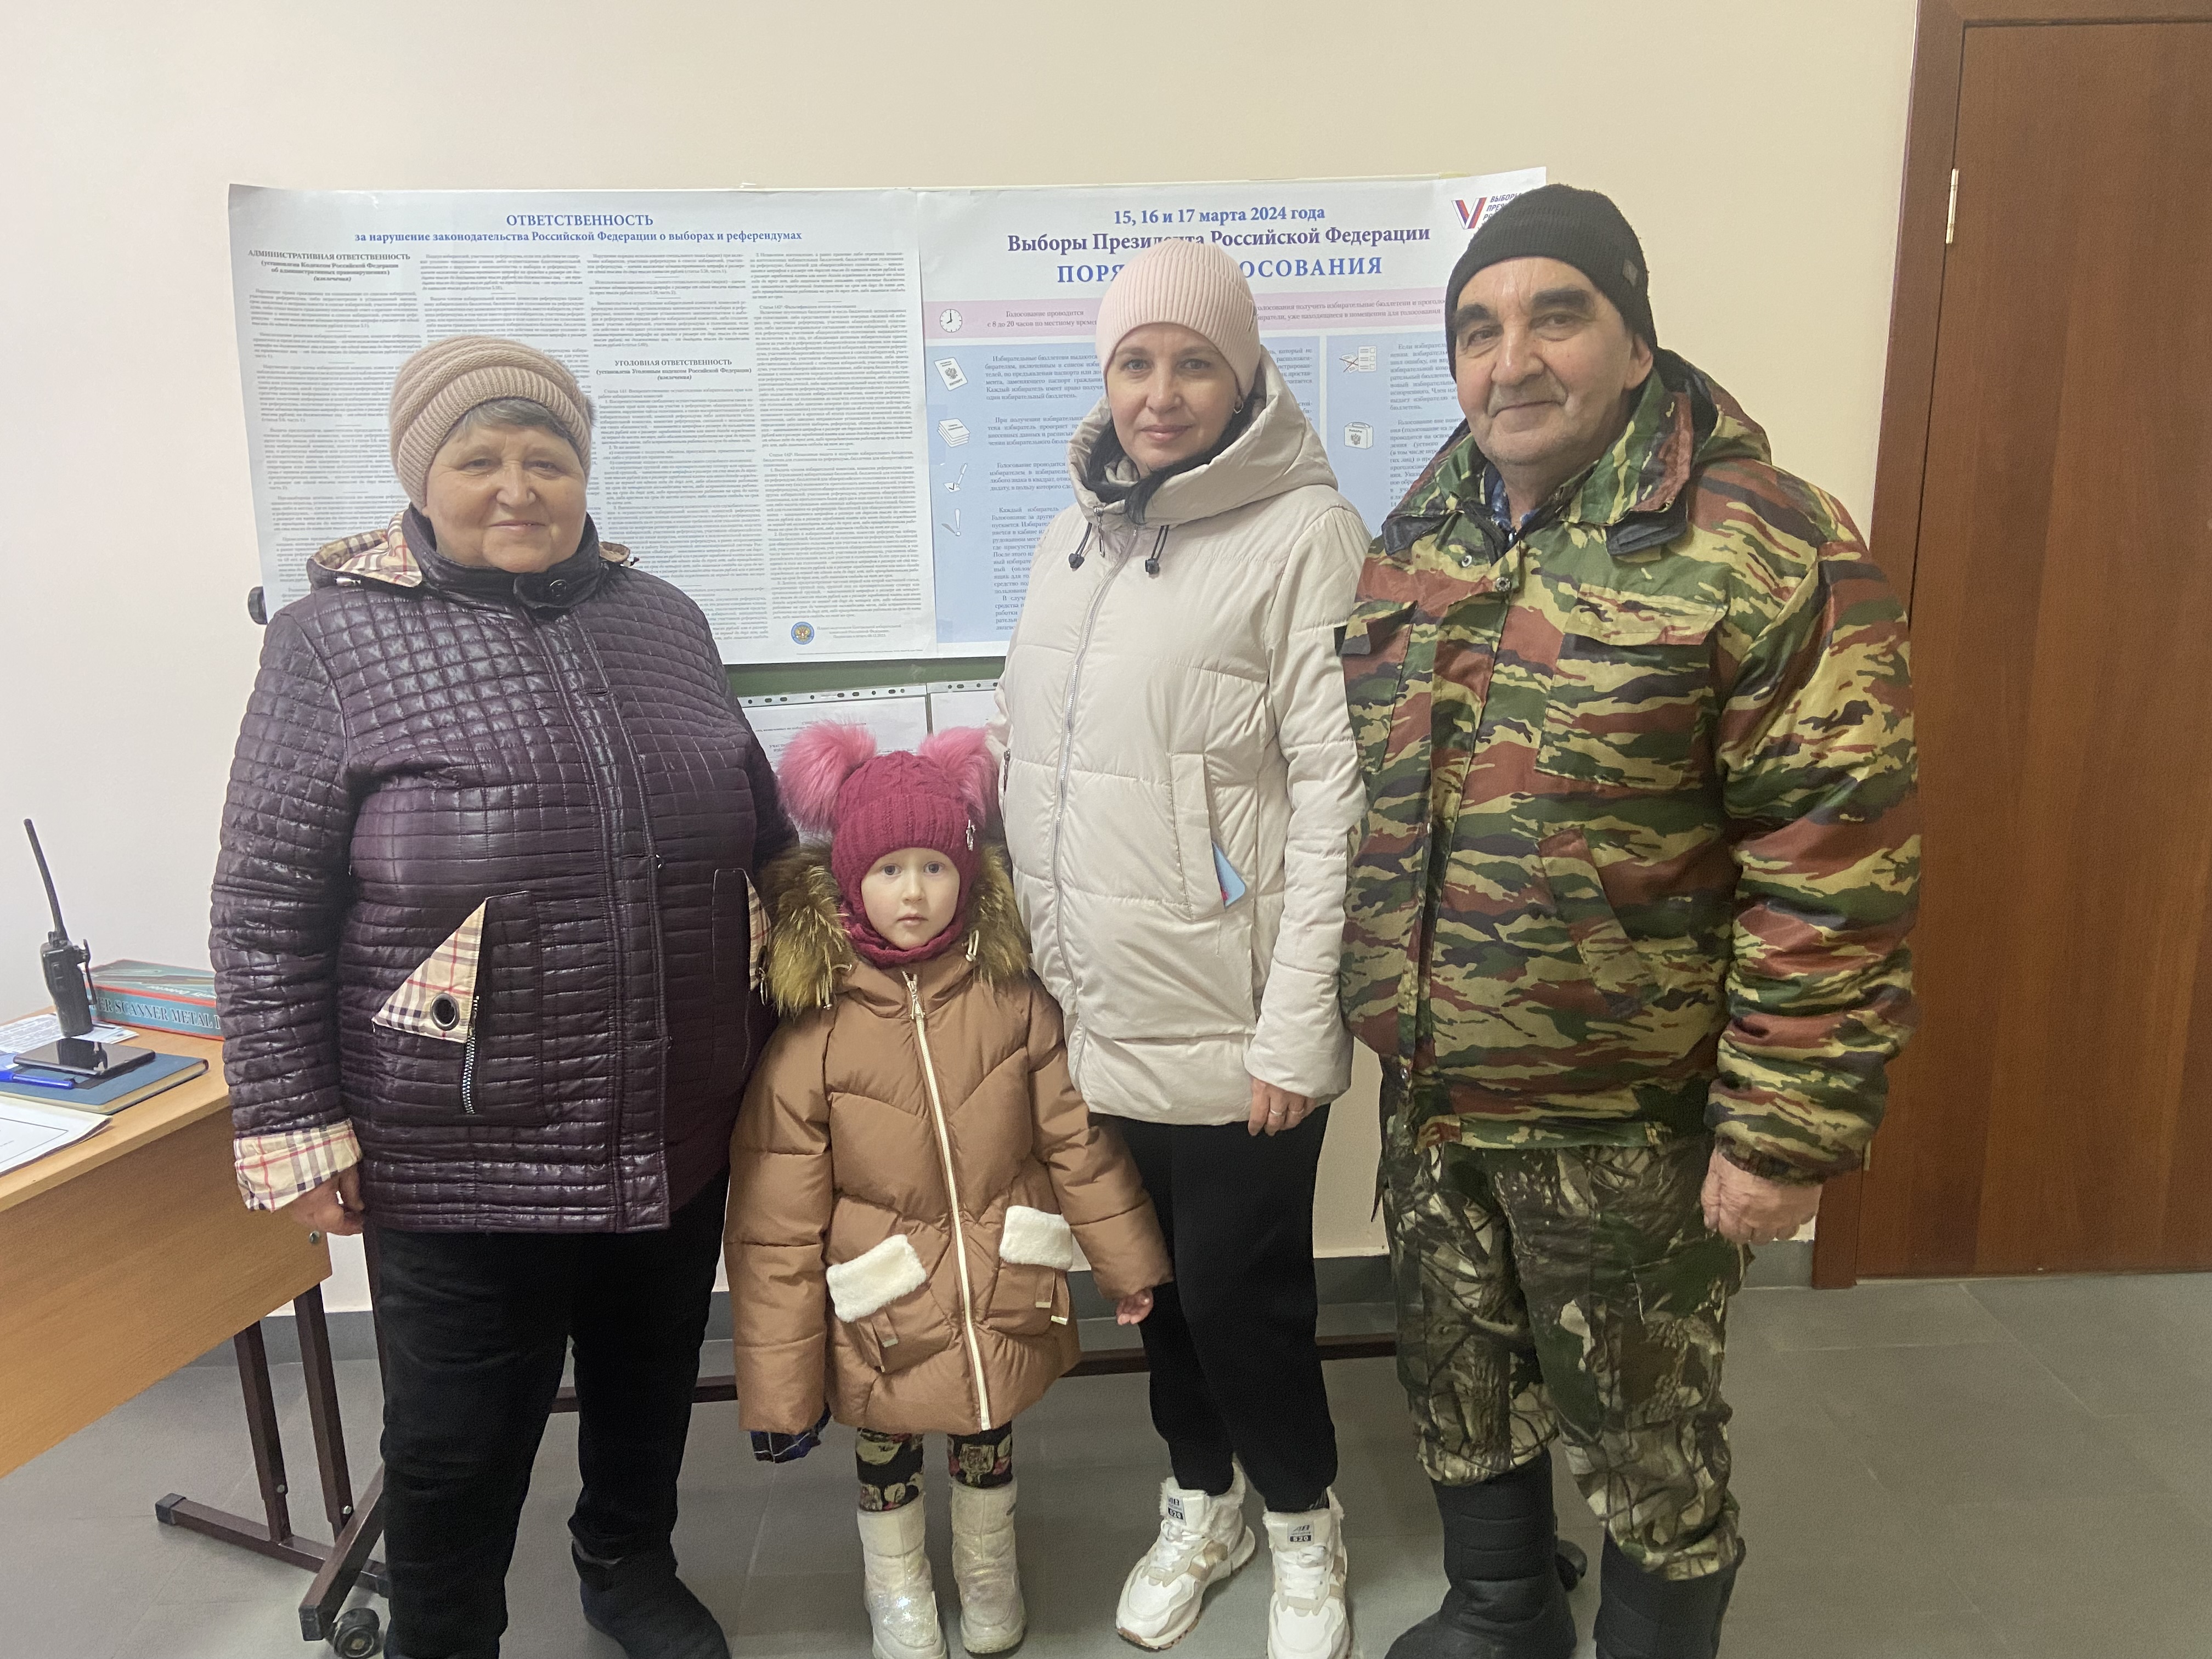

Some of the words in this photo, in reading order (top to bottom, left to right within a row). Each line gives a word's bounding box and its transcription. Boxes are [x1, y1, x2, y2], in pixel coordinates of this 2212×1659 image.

[506, 215, 653, 226] ОТВЕТСТВЕННОСТЬ
[1114, 210, 1136, 226] 15,
[1141, 210, 1158, 223] 16
[1163, 213, 1172, 223] и
[1178, 209, 1195, 223] 17
[1199, 211, 1246, 225] марта
[1251, 207, 1286, 221] 2024
[1291, 207, 1325, 222] года
[355, 233, 366, 242] за
[369, 232, 430, 244] нарушение
[433, 231, 529, 242] законодательства
[532, 231, 595, 241] Российской
[597, 231, 657, 242] Федерации
[668, 229, 714, 242] выборах
[726, 229, 802, 242] референдумах
[1008, 234, 1087, 256] Выборы
[1092, 233, 1204, 255] Презита
[1210, 227, 1320, 246] Российской
[1325, 227, 1431, 247] Федерации
[248, 250, 335, 260] АДМИНИСТРАТИВНАЯ
[1057, 264, 1124, 283] ПОРЯ
[1239, 257, 1382, 278] ОСОВАНИЯ
[1296, 302, 1326, 311] получить
[1327, 301, 1375, 309] избирательные
[1376, 300, 1411, 308] бюллетени
[114, 998, 170, 1022] SCANNER
[171, 1008, 213, 1029] METAL
